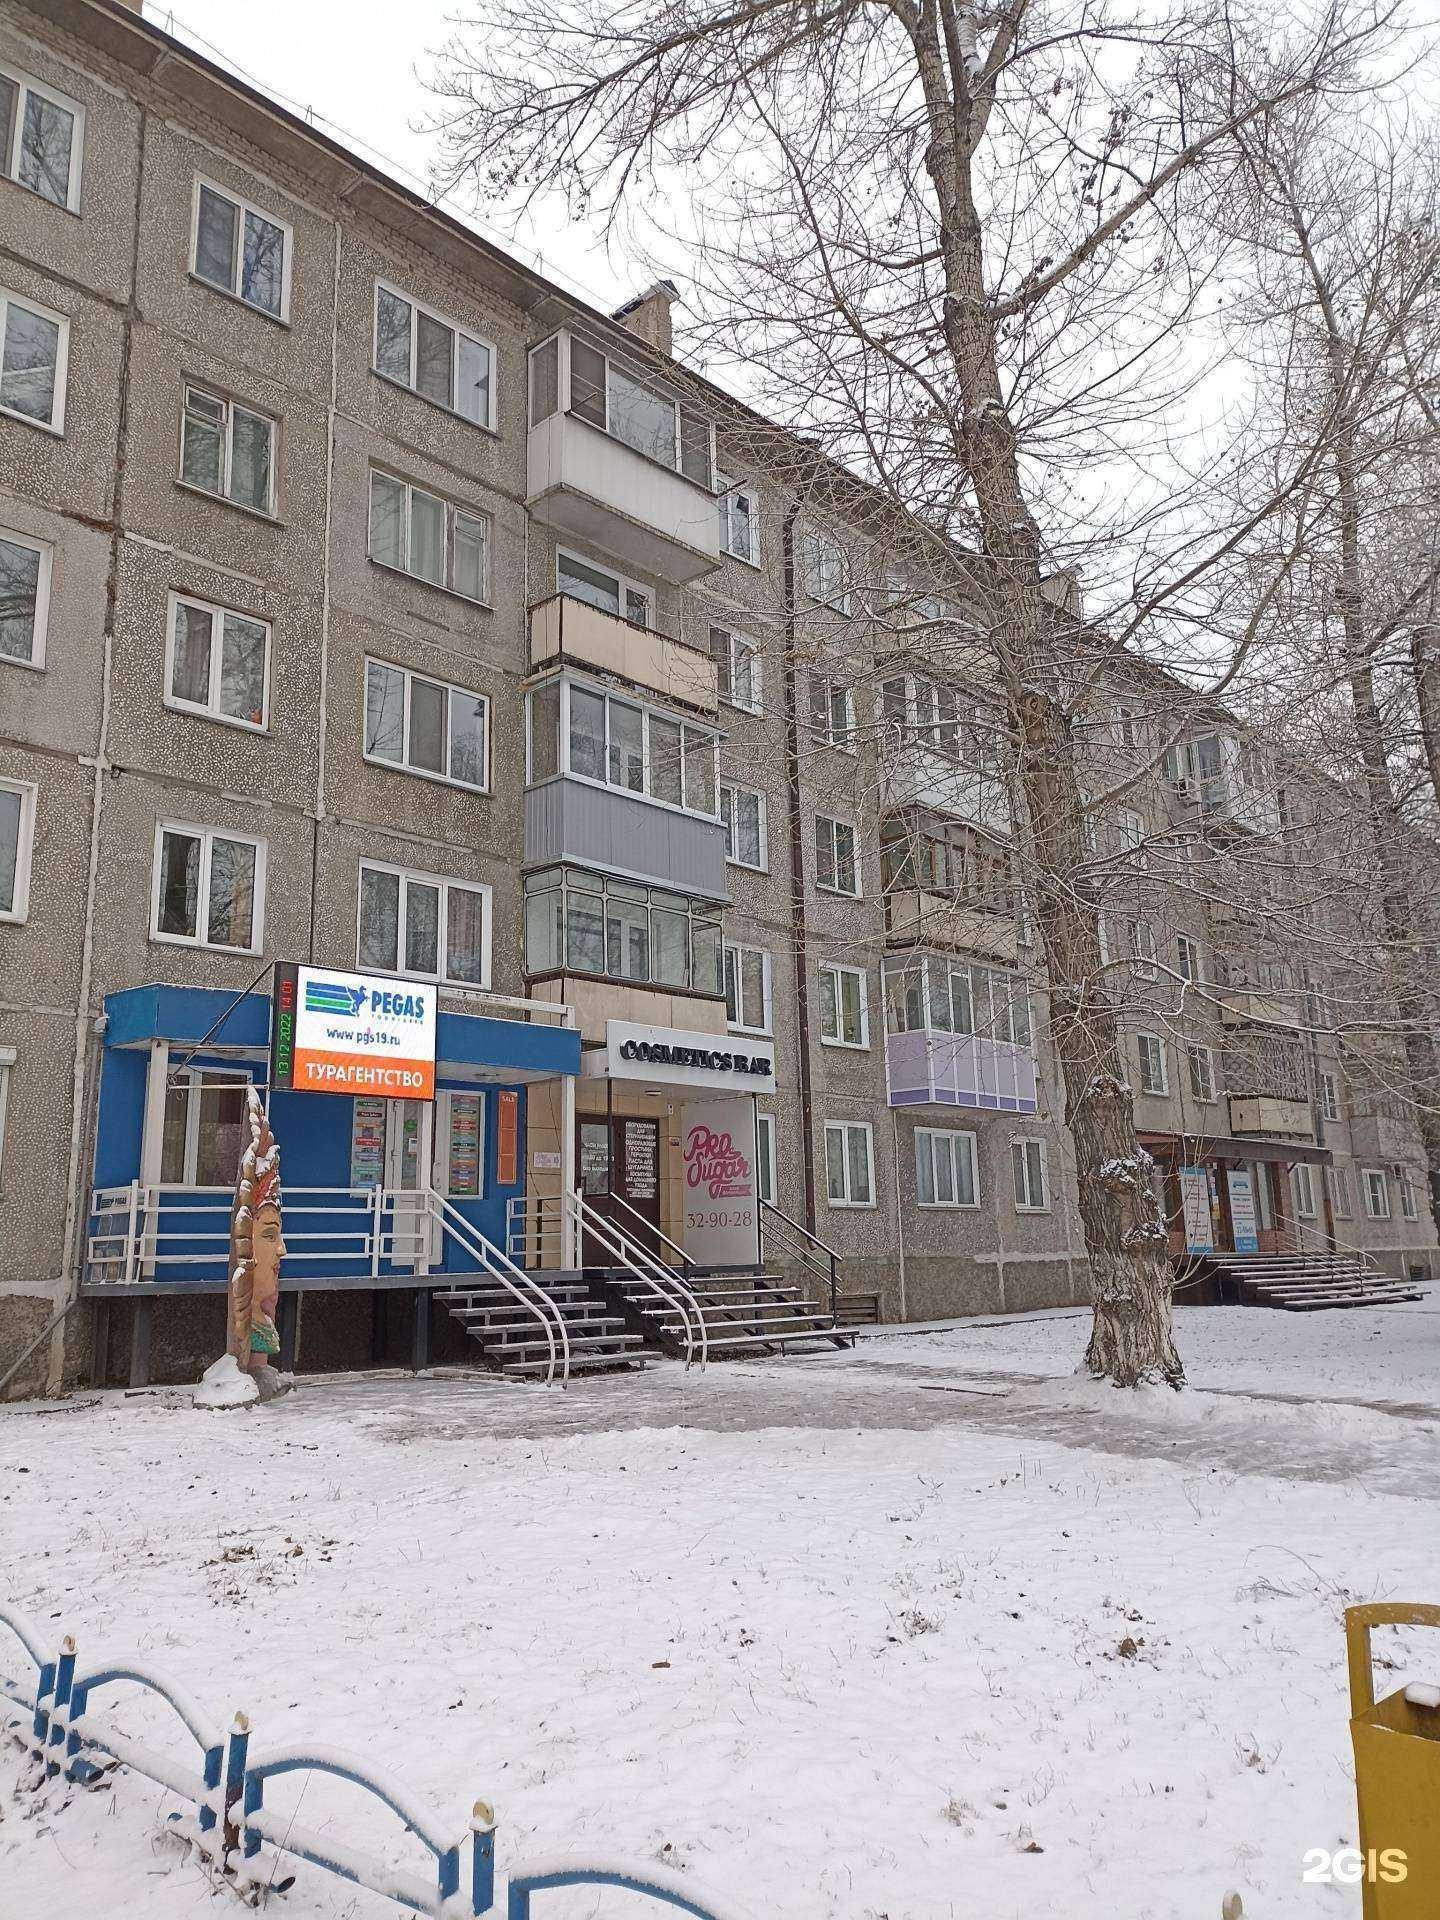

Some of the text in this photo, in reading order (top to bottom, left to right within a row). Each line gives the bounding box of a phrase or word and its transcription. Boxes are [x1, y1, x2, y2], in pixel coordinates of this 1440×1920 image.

[371, 991, 425, 1019] PEGAS
[326, 1029, 401, 1046] wwwpgs19.ru
[620, 1039, 772, 1076] COSMETICS BAR
[305, 1062, 424, 1088] ТУРАГЕНТСТВО
[687, 1151, 752, 1199] Sugar
[686, 1211, 753, 1229] 32-90-28
